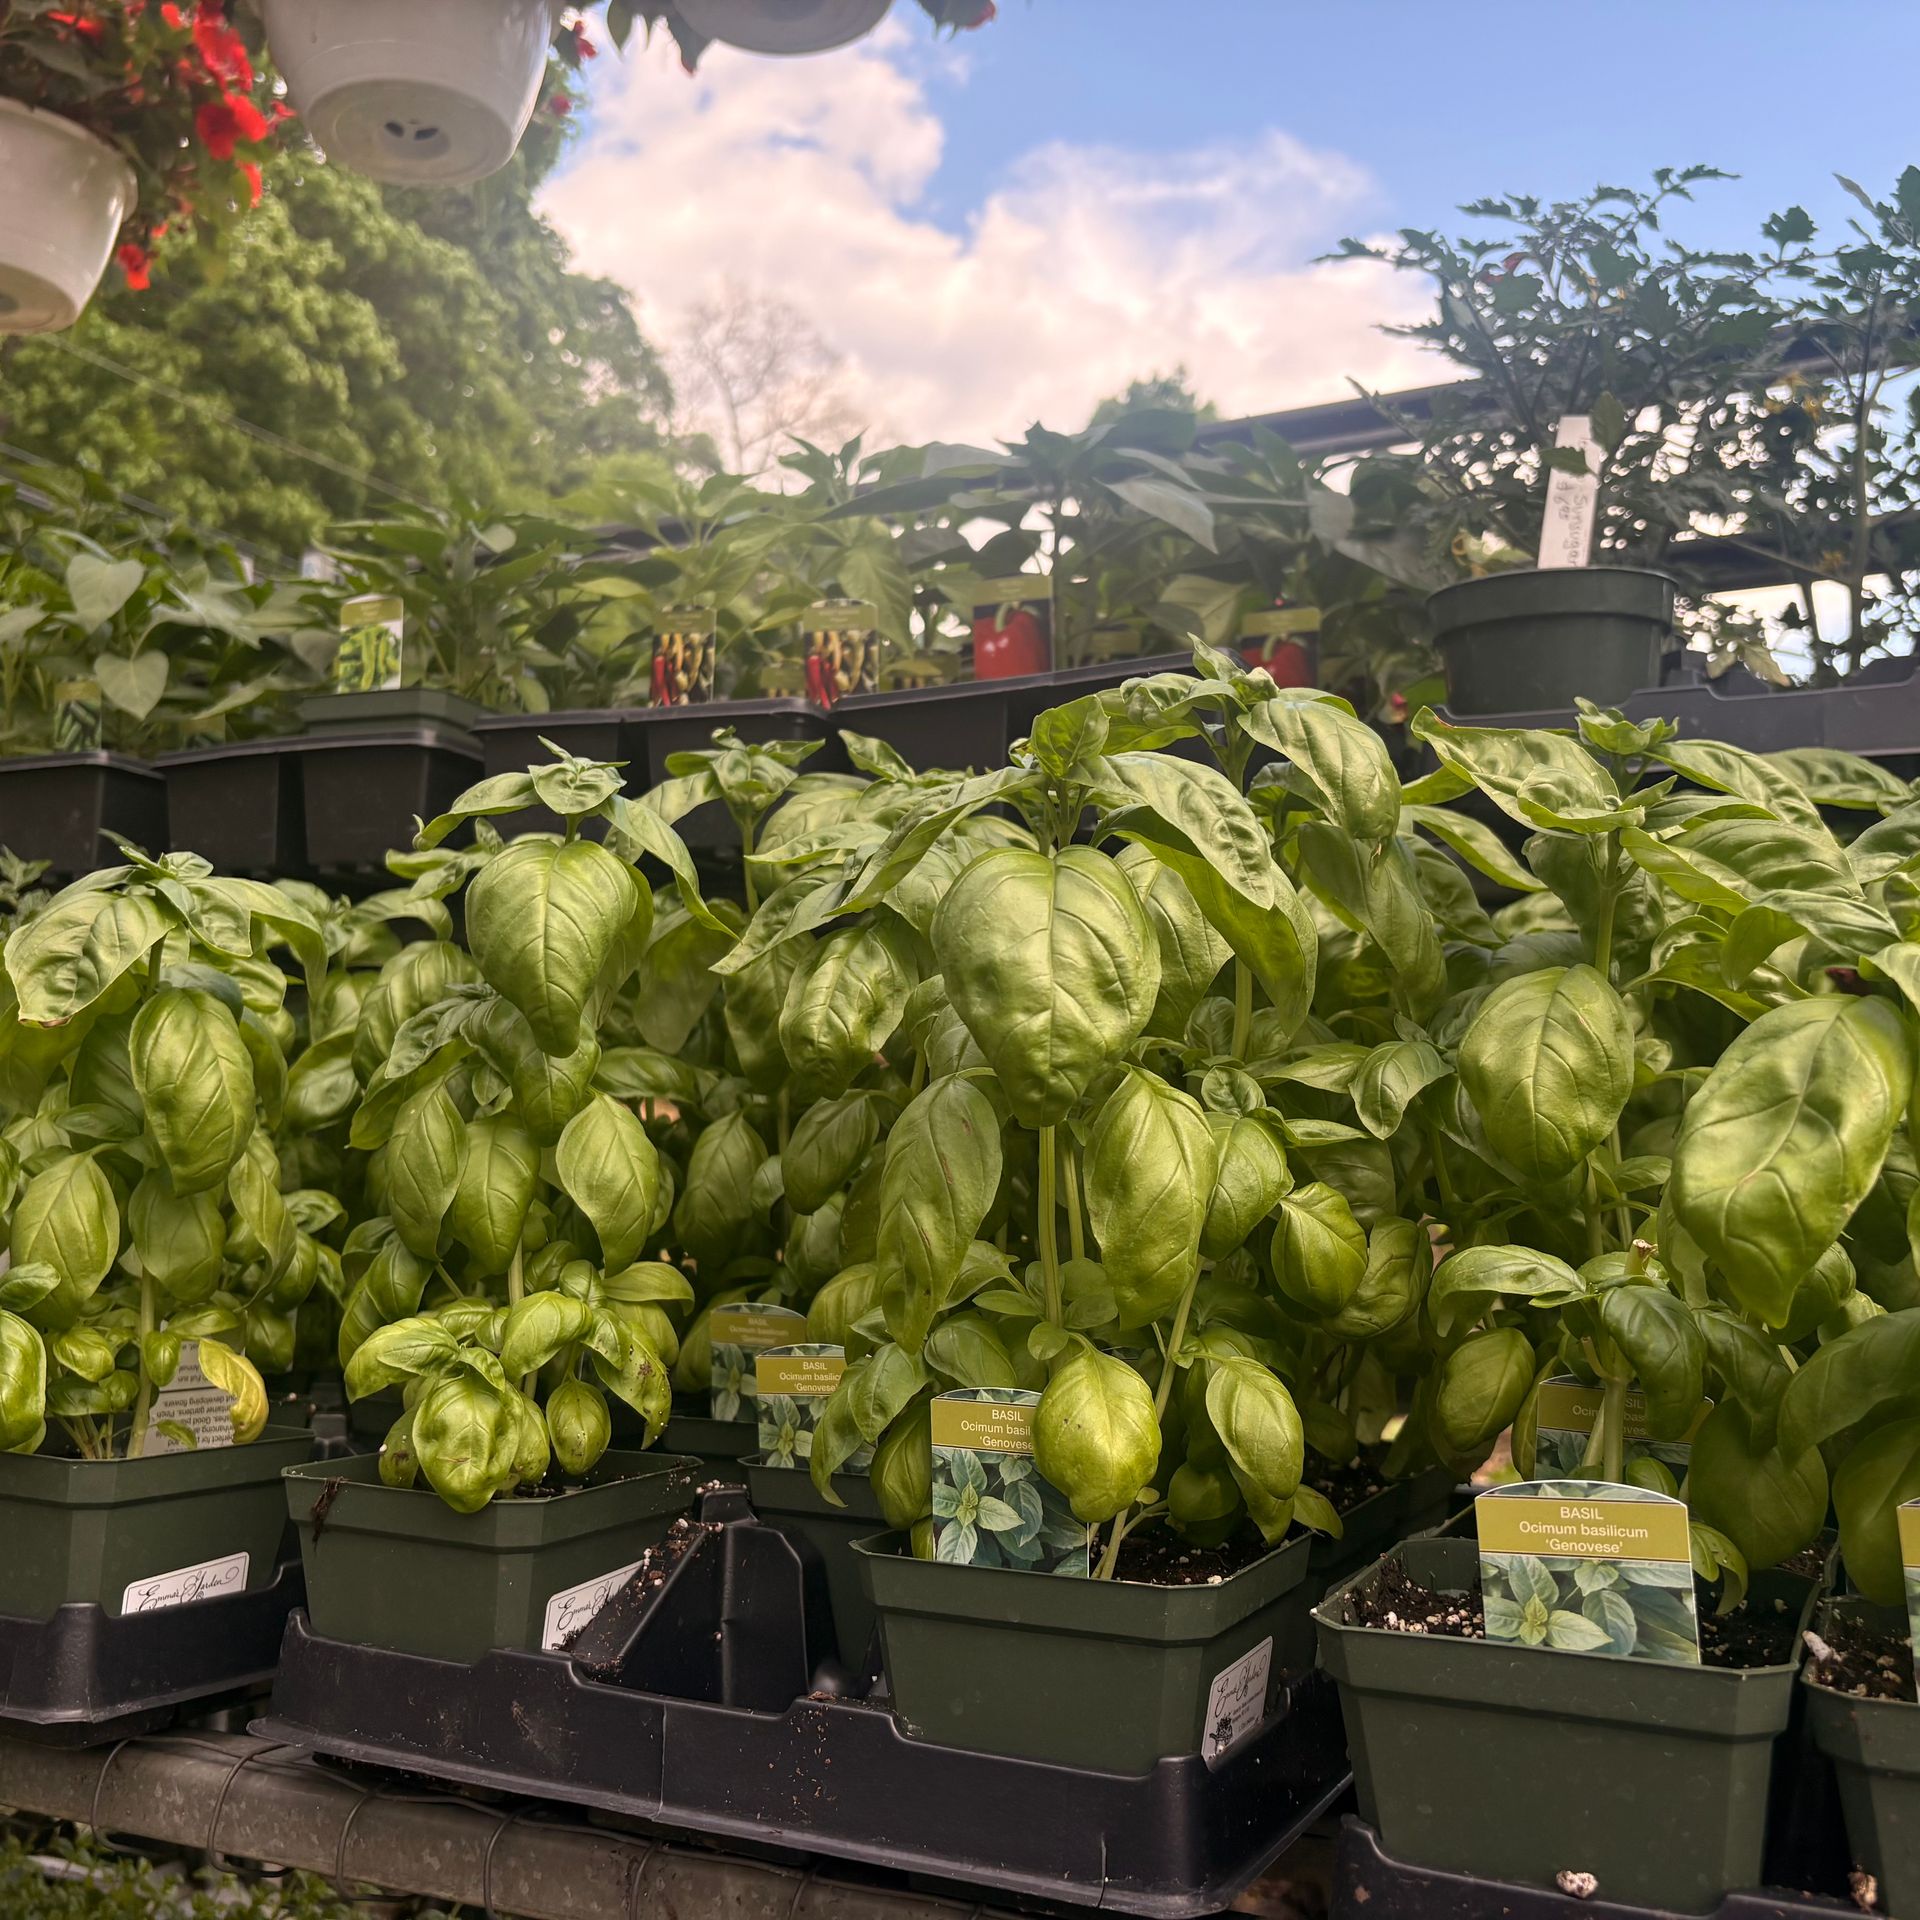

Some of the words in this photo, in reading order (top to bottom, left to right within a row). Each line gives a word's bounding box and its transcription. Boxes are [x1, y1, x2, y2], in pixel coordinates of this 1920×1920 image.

[803, 1361, 828, 1370] BASIL
[779, 1371, 813, 1381] Ocimum
[814, 1372, 841, 1382] basilic
[164, 1399, 188, 1408] flowers.
[189, 1396, 225, 1406] developing
[1624, 1397, 1645, 1409] SIL
[156, 1410, 175, 1418] Pinch
[177, 1407, 205, 1416] gardens.
[206, 1405, 231, 1414] ntainer
[192, 1416, 211, 1425] Good
[991, 1409, 1025, 1422] BASIL
[201, 1425, 233, 1434] nhancing
[961, 1420, 1003, 1434] Ocimum
[1006, 1424, 1032, 1436] basil
[980, 1436, 1034, 1451] 'Genovese
[1560, 1506, 1604, 1520] BASIL
[1519, 1520, 1577, 1535] Ocimum
[1580, 1523, 1649, 1538] basilicum
[1545, 1538, 1623, 1553] 'Genovese'
